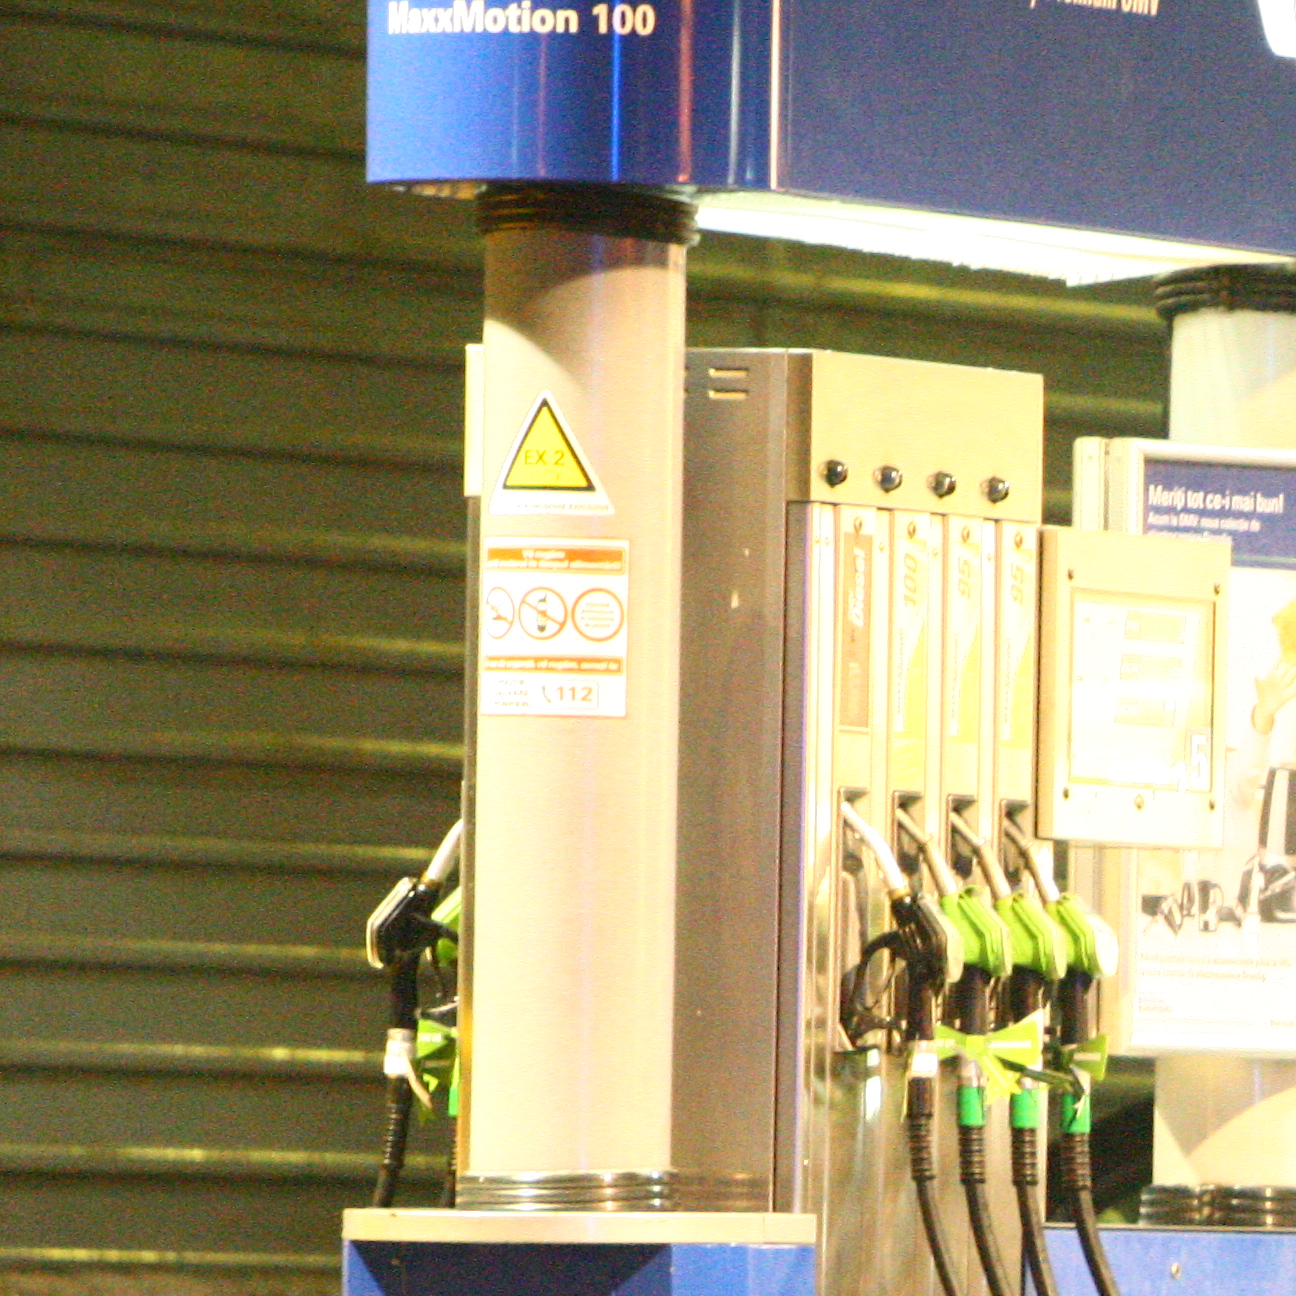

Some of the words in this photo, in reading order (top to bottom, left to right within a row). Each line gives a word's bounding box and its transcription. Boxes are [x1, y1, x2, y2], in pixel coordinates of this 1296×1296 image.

[387, 2, 579, 35] MaxxMotion
[592, 4, 656, 36] 100
[523, 449, 548, 466] EX
[553, 450, 566, 467] 2
[1186, 490, 1205, 509] tot
[1206, 489, 1230, 510] ce-i
[1231, 492, 1255, 512] mai
[1256, 493, 1285, 514] bun!
[849, 547, 866, 628] Diesel
[903, 552, 919, 607] 100
[957, 556, 972, 600] 95
[1009, 561, 1024, 606] 95
[557, 685, 594, 702] 112
